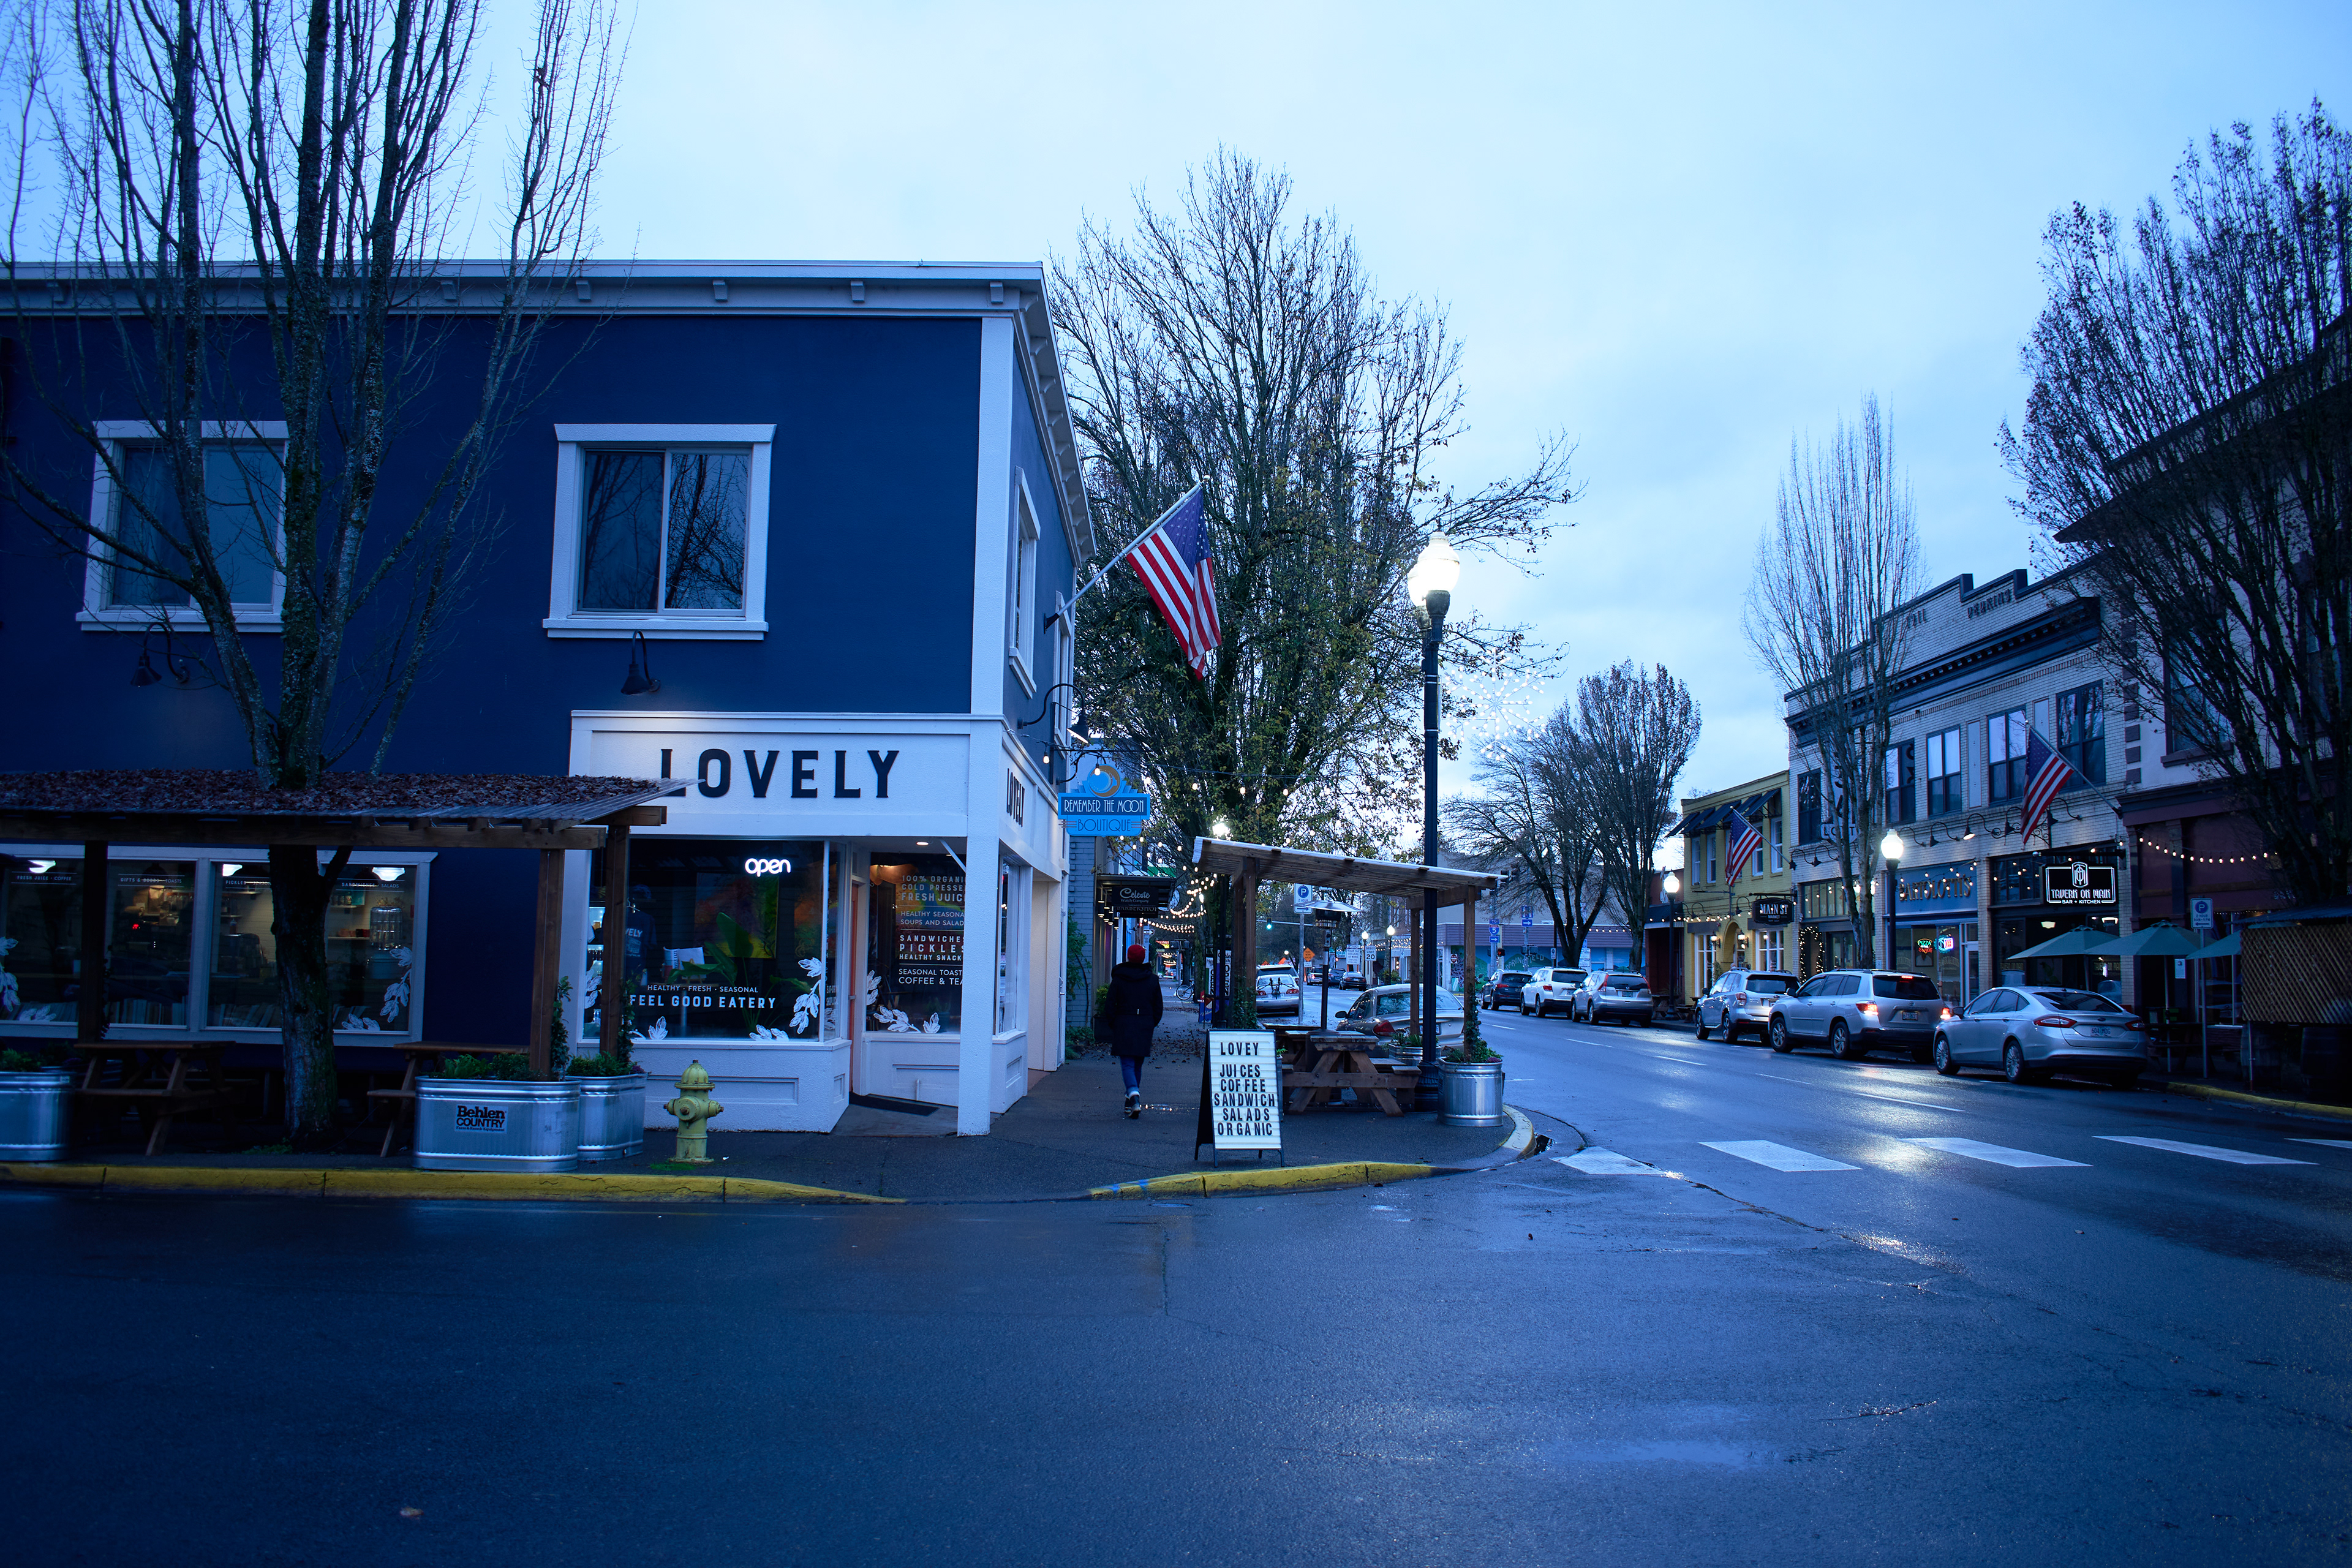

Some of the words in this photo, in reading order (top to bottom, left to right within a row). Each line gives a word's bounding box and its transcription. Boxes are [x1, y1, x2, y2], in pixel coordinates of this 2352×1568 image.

[660, 748, 900, 798] LOVELY
[1006, 768, 1025, 827] LOVELY
[1064, 799, 1101, 812] REMEMBER
[1104, 799, 1114, 812] THE
[1118, 799, 1144, 813] MOON
[1078, 819, 1131, 832] BOUTIQUE
[1824, 826, 1855, 836] LOT
[744, 858, 791, 877] open
[902, 892, 935, 902] FRESH
[938, 893, 964, 902] JUIC
[1120, 888, 1151, 899] Celeste
[2051, 889, 2078, 899] TAVERN
[2080, 889, 2090, 899] ON
[2093, 889, 2111, 899] MAIN
[1760, 903, 1779, 914] MAIN
[1779, 903, 1789, 914] ST
[630, 995, 665, 1006] FEEL
[671, 995, 712, 1008] GOOD
[718, 997, 776, 1009] EATERY
[1220, 1042, 1259, 1055] LOVEY
[1219, 1064, 1261, 1077] JUICES
[1220, 1079, 1266, 1092] COFFEE
[1214, 1093, 1275, 1107] SANDWICH
[458, 1106, 505, 1118] Behlen
[1223, 1107, 1270, 1121] SALADS
[457, 1118, 505, 1128] COUNTRY
[1217, 1122, 1273, 1136] ORGANIC
